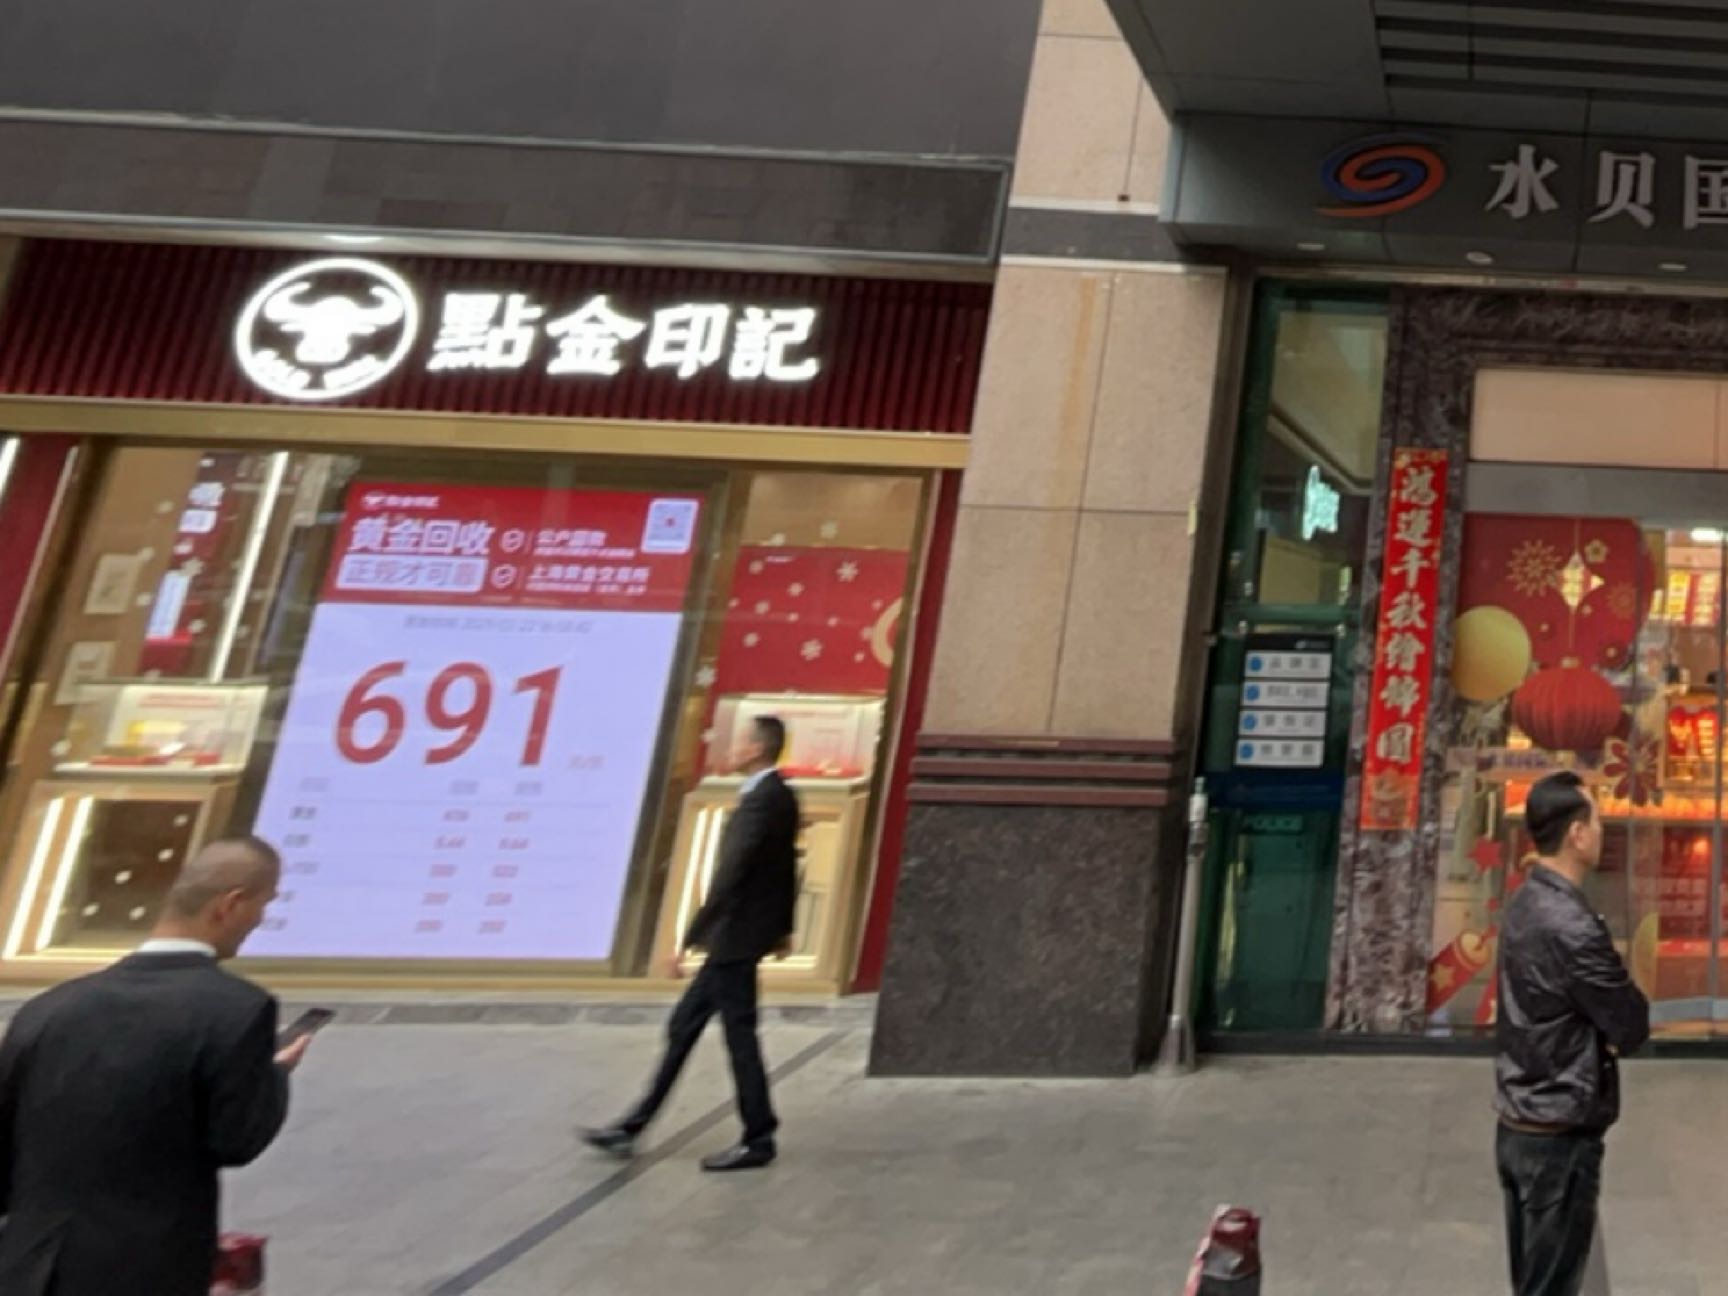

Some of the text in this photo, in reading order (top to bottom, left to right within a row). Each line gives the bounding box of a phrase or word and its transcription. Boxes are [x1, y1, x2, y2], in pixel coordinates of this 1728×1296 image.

[426, 293, 821, 382] 點金印記
[349, 516, 495, 554] 黄金回收
[334, 661, 563, 767] 691
